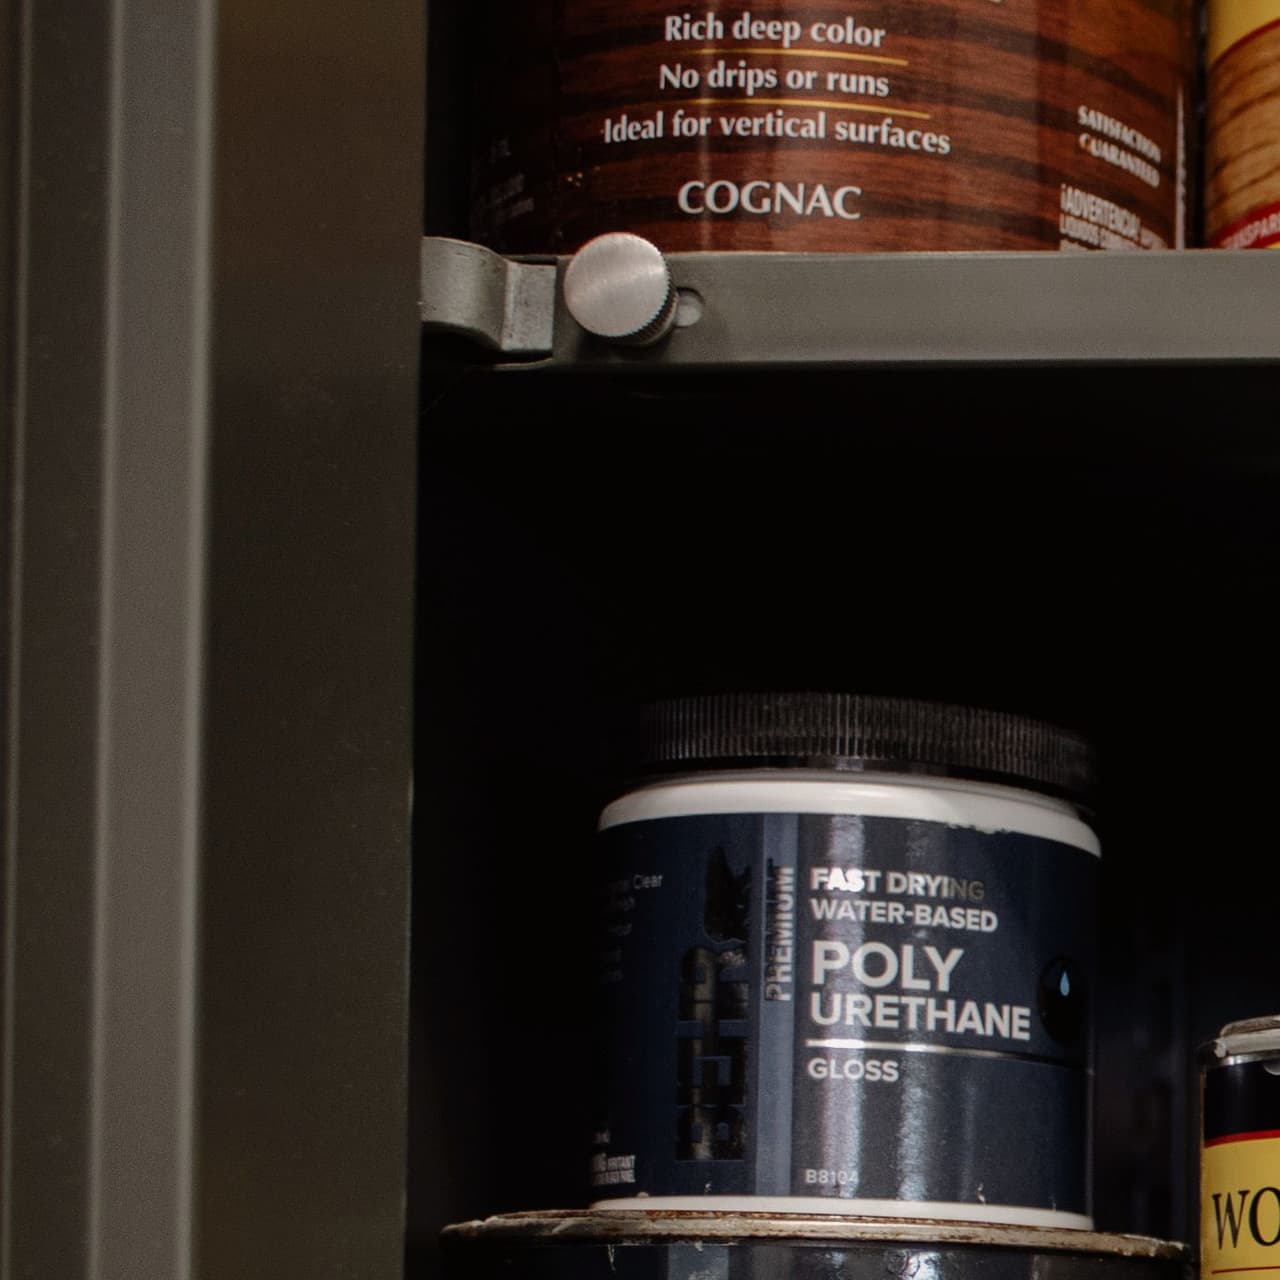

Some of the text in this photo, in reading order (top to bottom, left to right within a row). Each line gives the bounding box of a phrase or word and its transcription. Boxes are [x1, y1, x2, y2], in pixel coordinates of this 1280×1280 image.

[665, 12, 885, 48] Rich deep color
[660, 60, 889, 96] No drips or runs
[604, 110, 950, 155] Ideal for vertical surfaces
[678, 180, 862, 219] COGNAC
[810, 867, 985, 900] FAST DRYING
[811, 899, 999, 932] WATER-BASED
[812, 940, 964, 991] POLY
[811, 993, 1031, 1041] URETHANE
[808, 1058, 899, 1082] GLOSS
